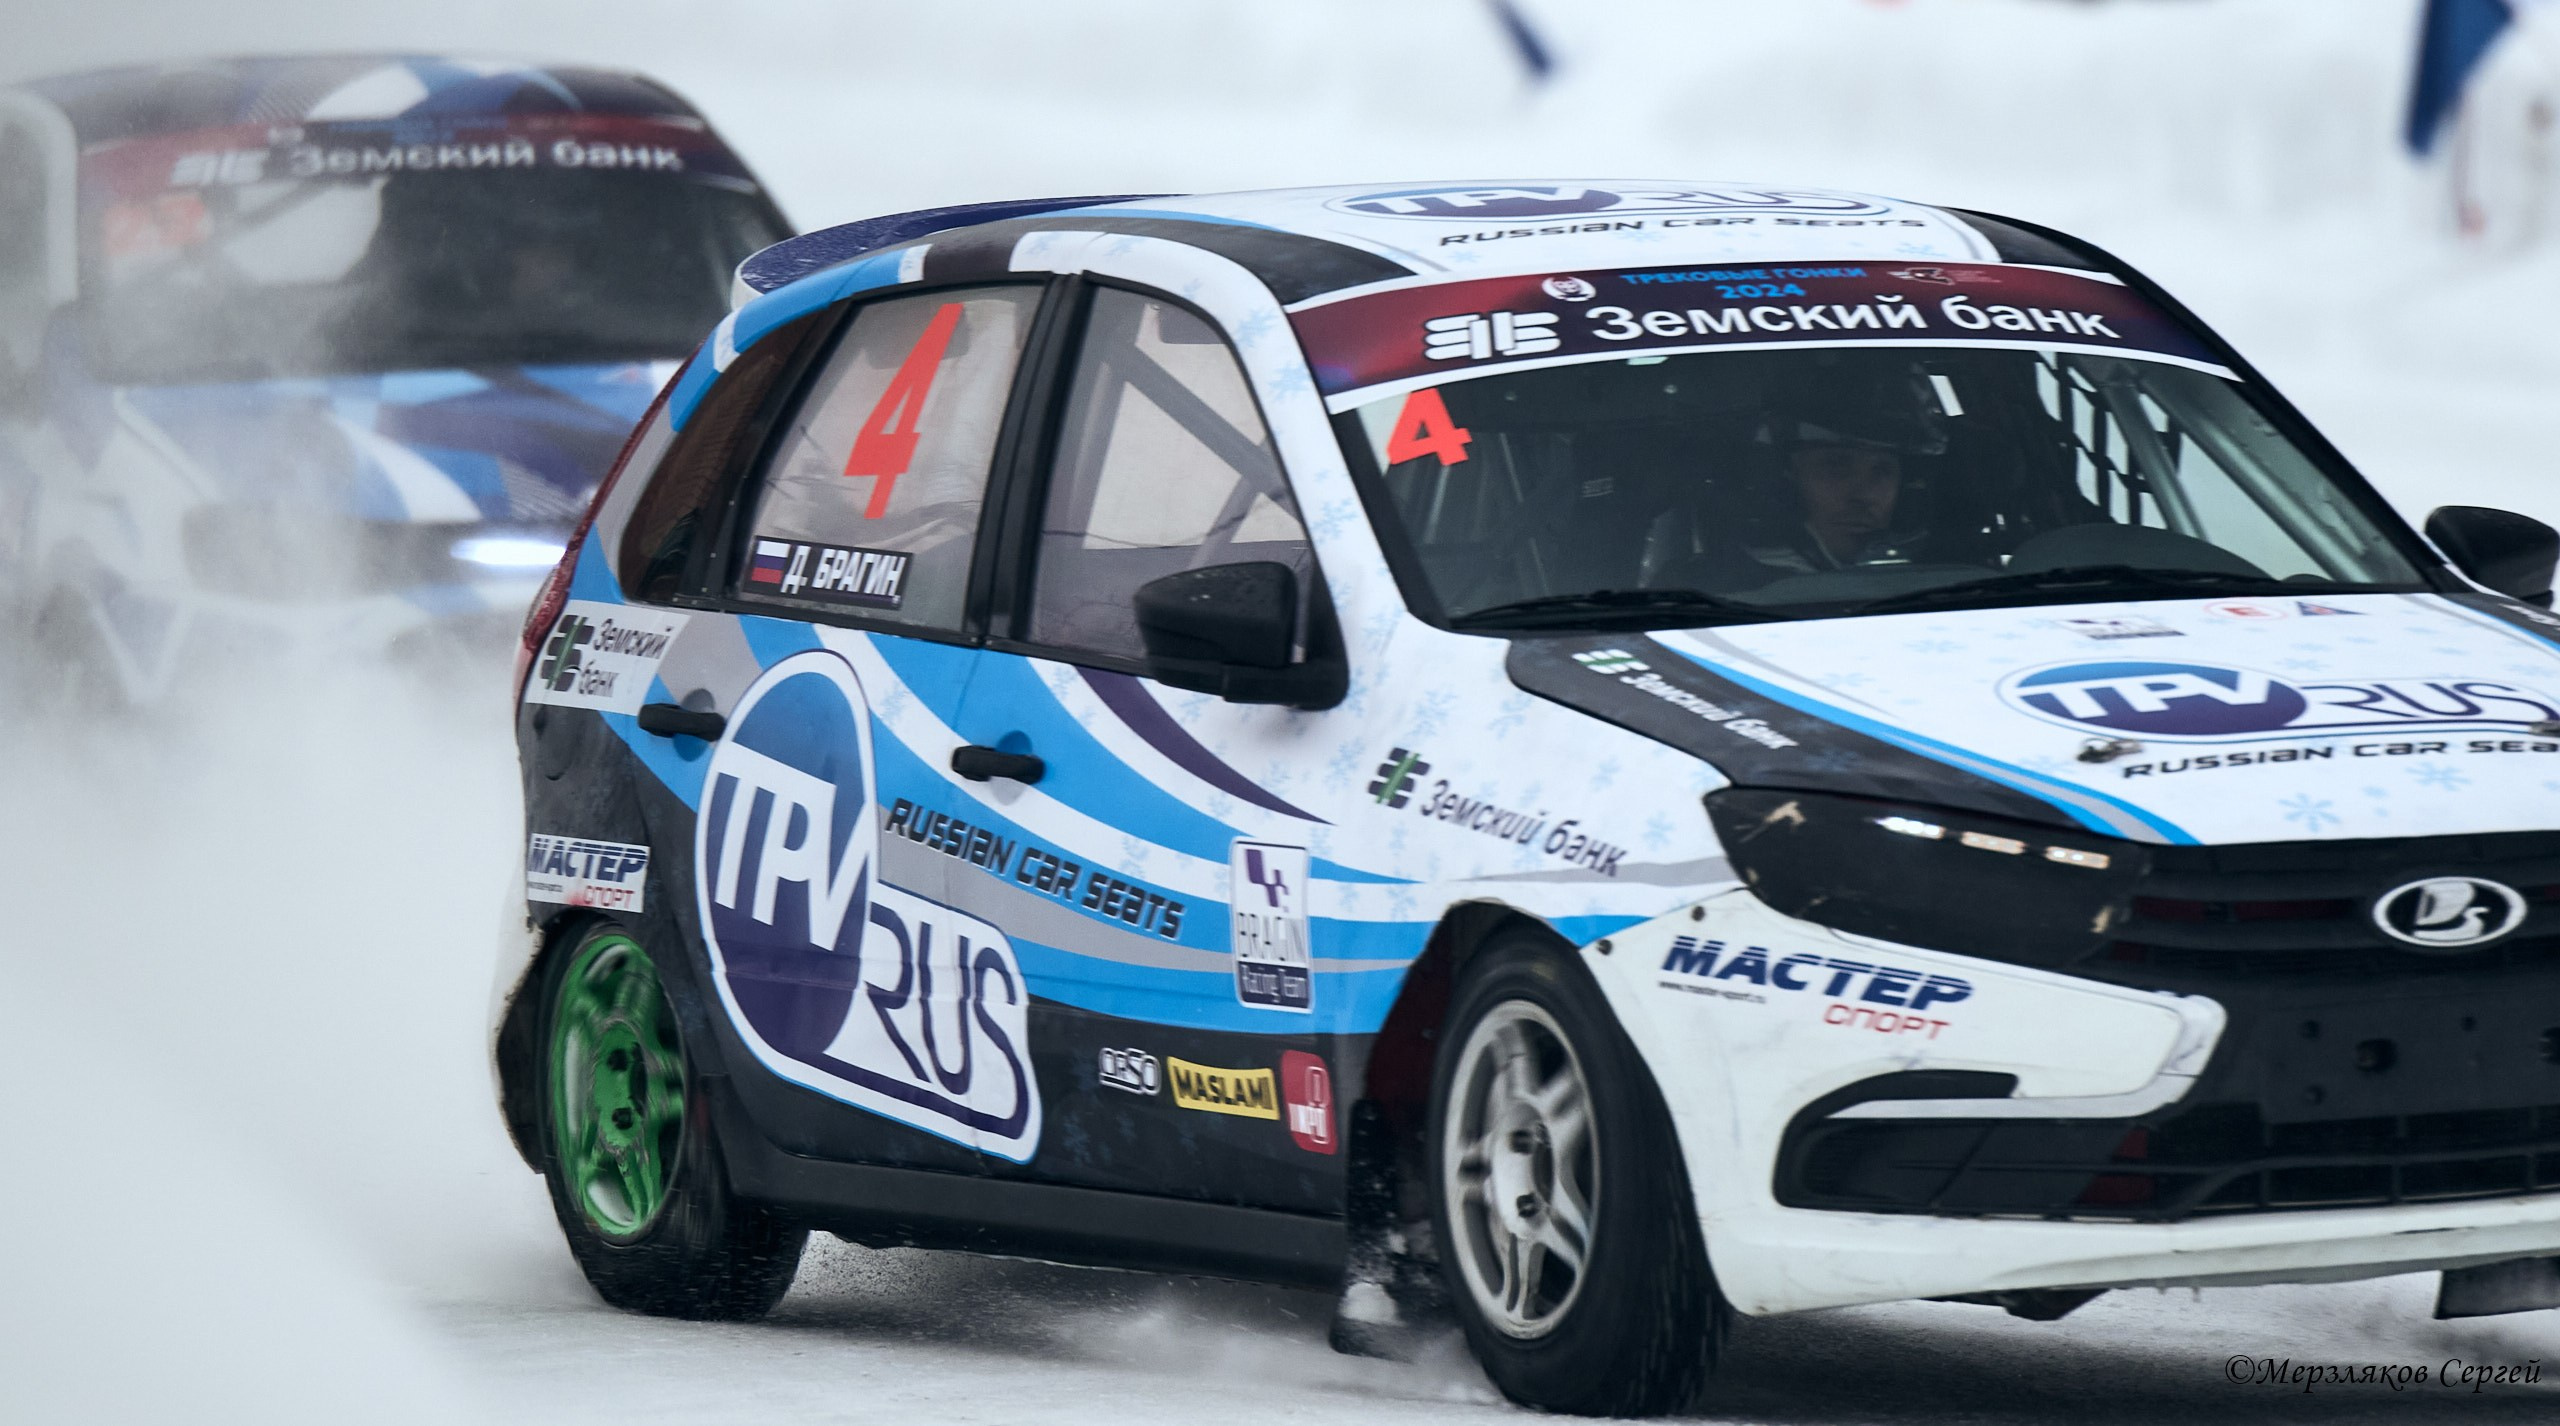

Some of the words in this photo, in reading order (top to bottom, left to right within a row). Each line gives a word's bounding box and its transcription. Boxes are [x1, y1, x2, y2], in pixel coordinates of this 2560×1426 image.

[553, 138, 685, 171] банк
[1619, 269, 1773, 286] ТРЕКОВЫЕ
[1775, 267, 1868, 279] ГОНКИ
[1715, 283, 1807, 300] 2024
[1586, 294, 1927, 341] Земский
[1940, 294, 2122, 339] банк
[843, 302, 964, 519] 4
[1386, 387, 1473, 466] 4
[780, 545, 811, 594] Д.
[811, 548, 907, 597] БРАГИН
[2017, 671, 2270, 718] TPV
[2300, 682, 2560, 724] RUS
[1420, 779, 1550, 844] Земский
[1544, 819, 1627, 877] банк
[528, 837, 648, 883] МАСТЕР
[706, 741, 870, 951] TPV
[863, 900, 1030, 1140] RUS
[1240, 964, 1281, 1004] Racing
[1278, 968, 1307, 999] Team
[1661, 935, 1975, 1010] МАСТЕР
[1823, 1003, 1950, 1040] СПОРТ
[1172, 1065, 1273, 1110] MASLAMI
